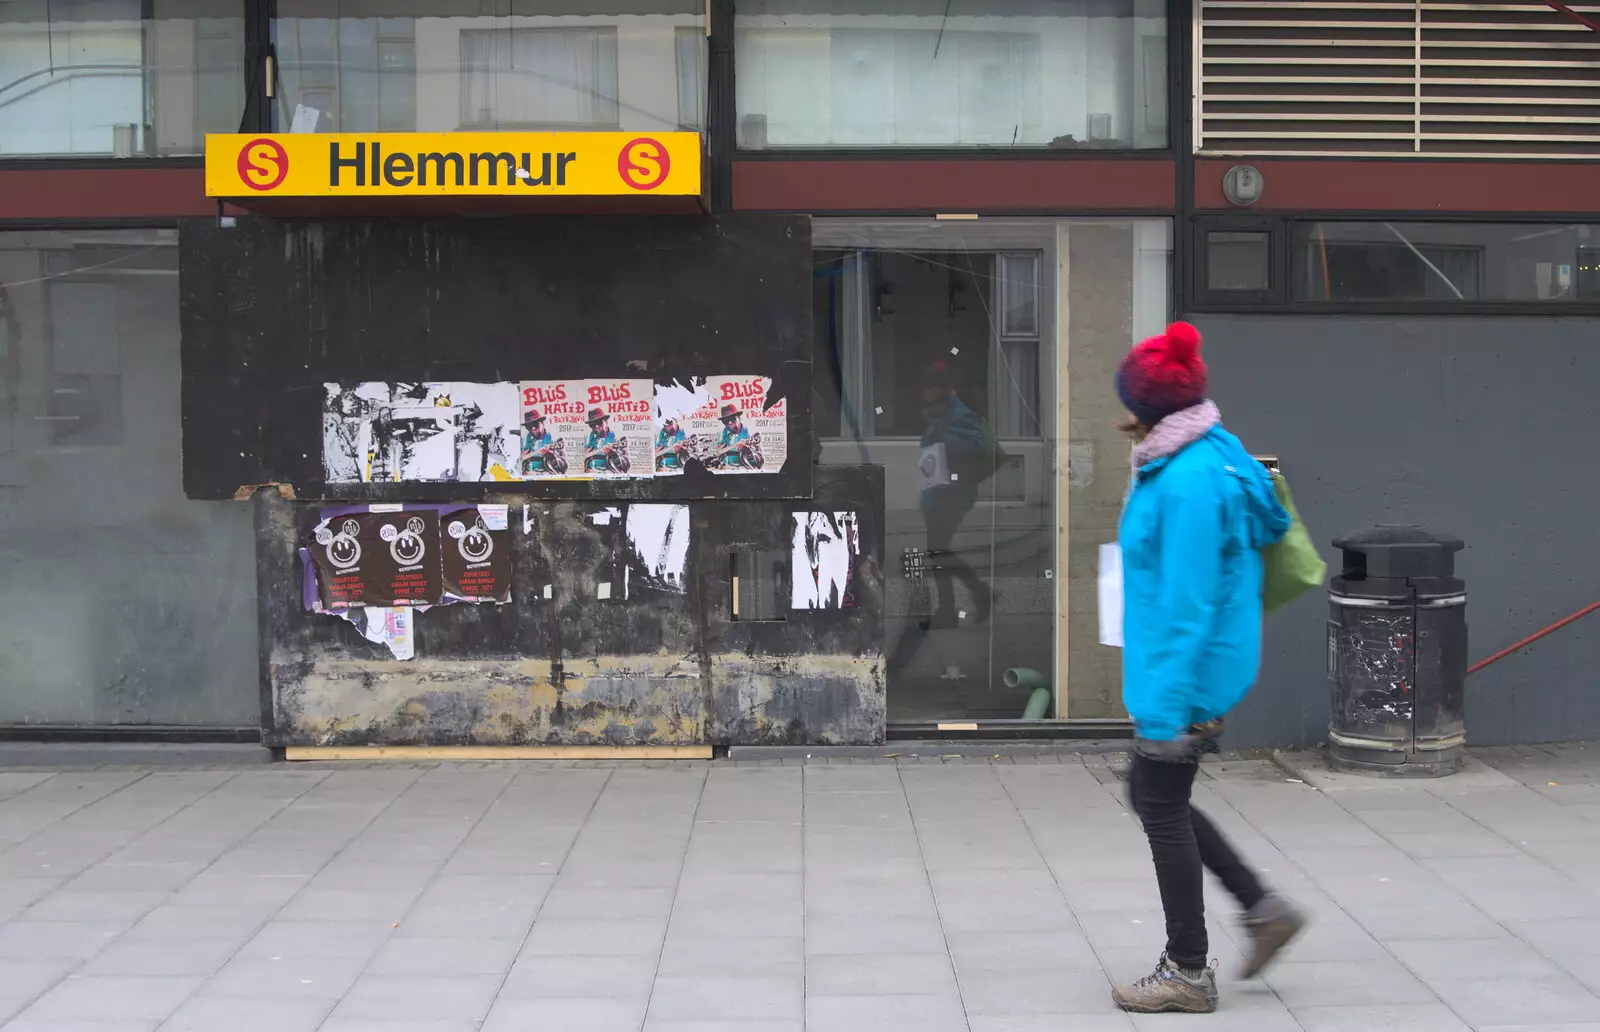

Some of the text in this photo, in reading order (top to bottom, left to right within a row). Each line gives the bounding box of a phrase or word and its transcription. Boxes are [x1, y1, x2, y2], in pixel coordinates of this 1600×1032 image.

[329, 142, 576, 187] Hlemmur
[523, 384, 567, 406] BLÚS
[587, 383, 631, 404] BLÚS
[720, 378, 764, 400] BLÚS
[558, 424, 572, 432] 2017
[622, 423, 636, 431] 2017
[691, 420, 705, 428] 2017
[755, 419, 769, 427] 2017
